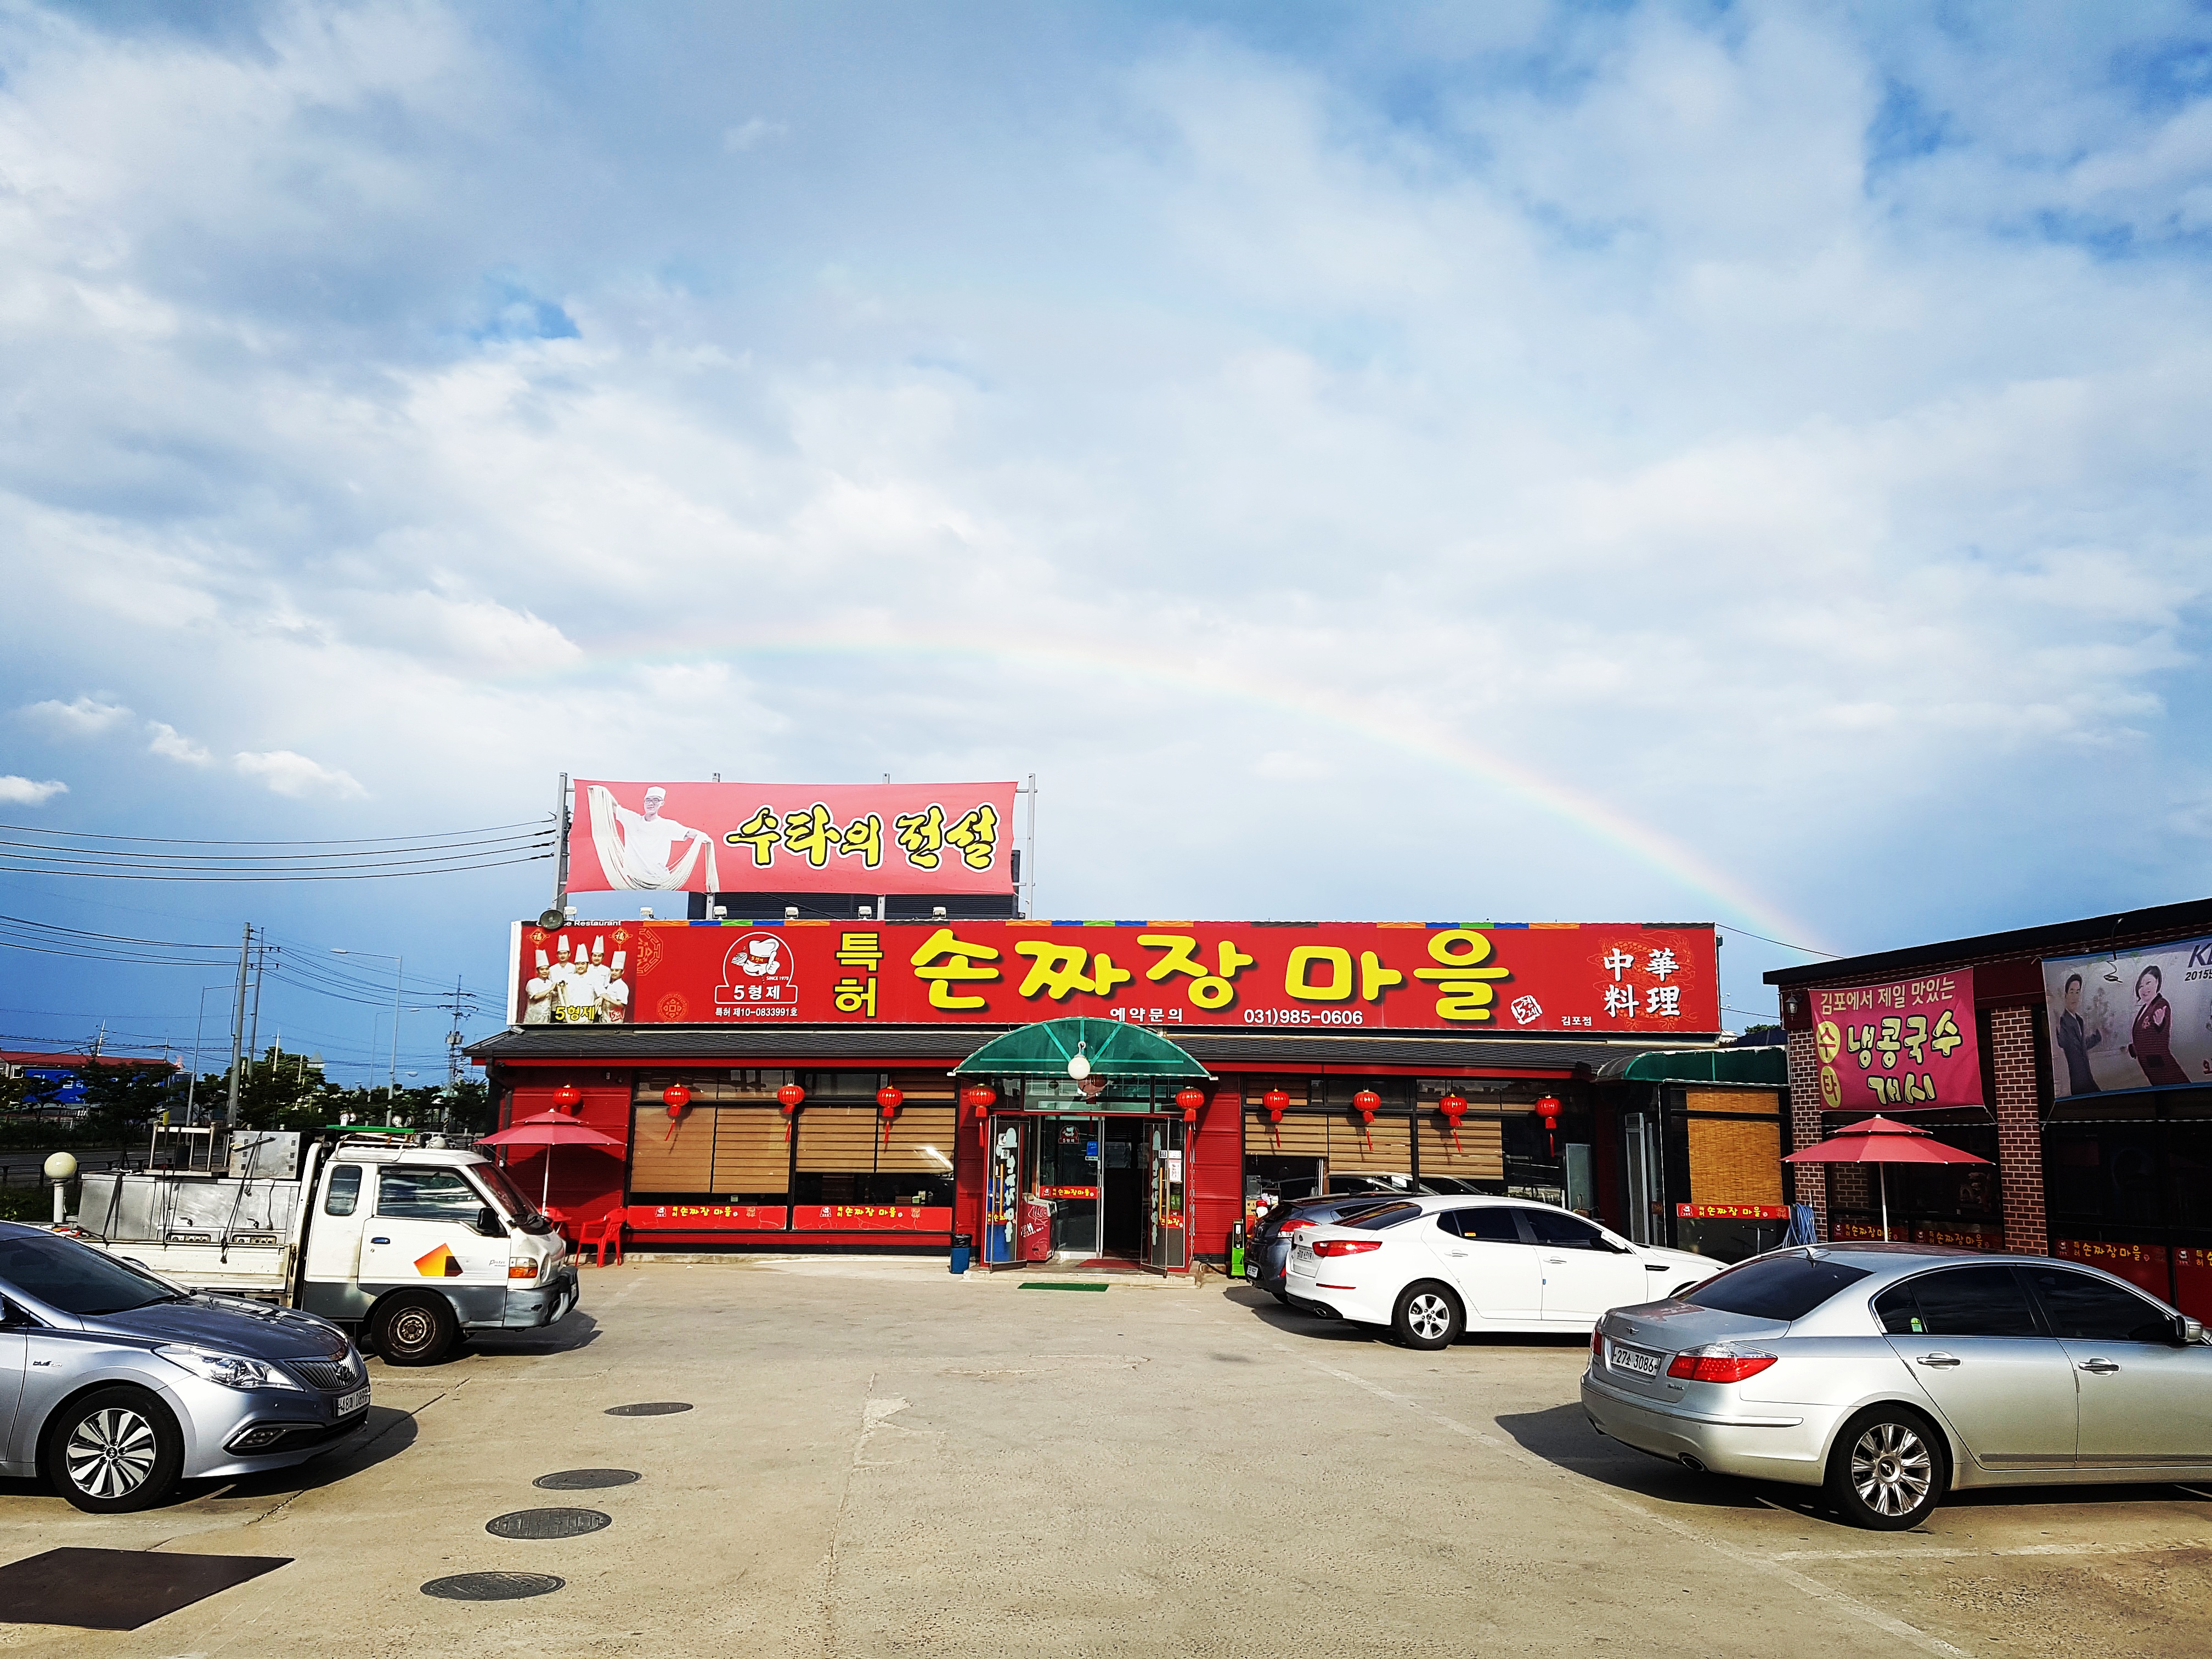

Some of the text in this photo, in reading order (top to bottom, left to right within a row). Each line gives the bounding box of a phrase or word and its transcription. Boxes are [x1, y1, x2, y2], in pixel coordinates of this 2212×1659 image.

[725, 804, 998, 869] 수타의 전설
[834, 932, 884, 1018] 특허
[911, 928, 1509, 1020] 손짜장 마을
[1603, 948, 1679, 981] 中華
[733, 985, 780, 1000] 5형제
[1604, 984, 1680, 1018] 料理
[1820, 977, 1955, 1015] 김포에서 제일 맛있는
[555, 1006, 595, 1020] 5형제
[715, 1007, 798, 1017] 특허 제10-0833991호
[1109, 1009, 1363, 1025] 예약문의 031)985-0606
[1561, 1016, 1592, 1026] 김포점
[1847, 1008, 1963, 1069] 냉콩국수
[1867, 1071, 1937, 1105] 개시
[1616, 1350, 1654, 1372] 27소 3086
